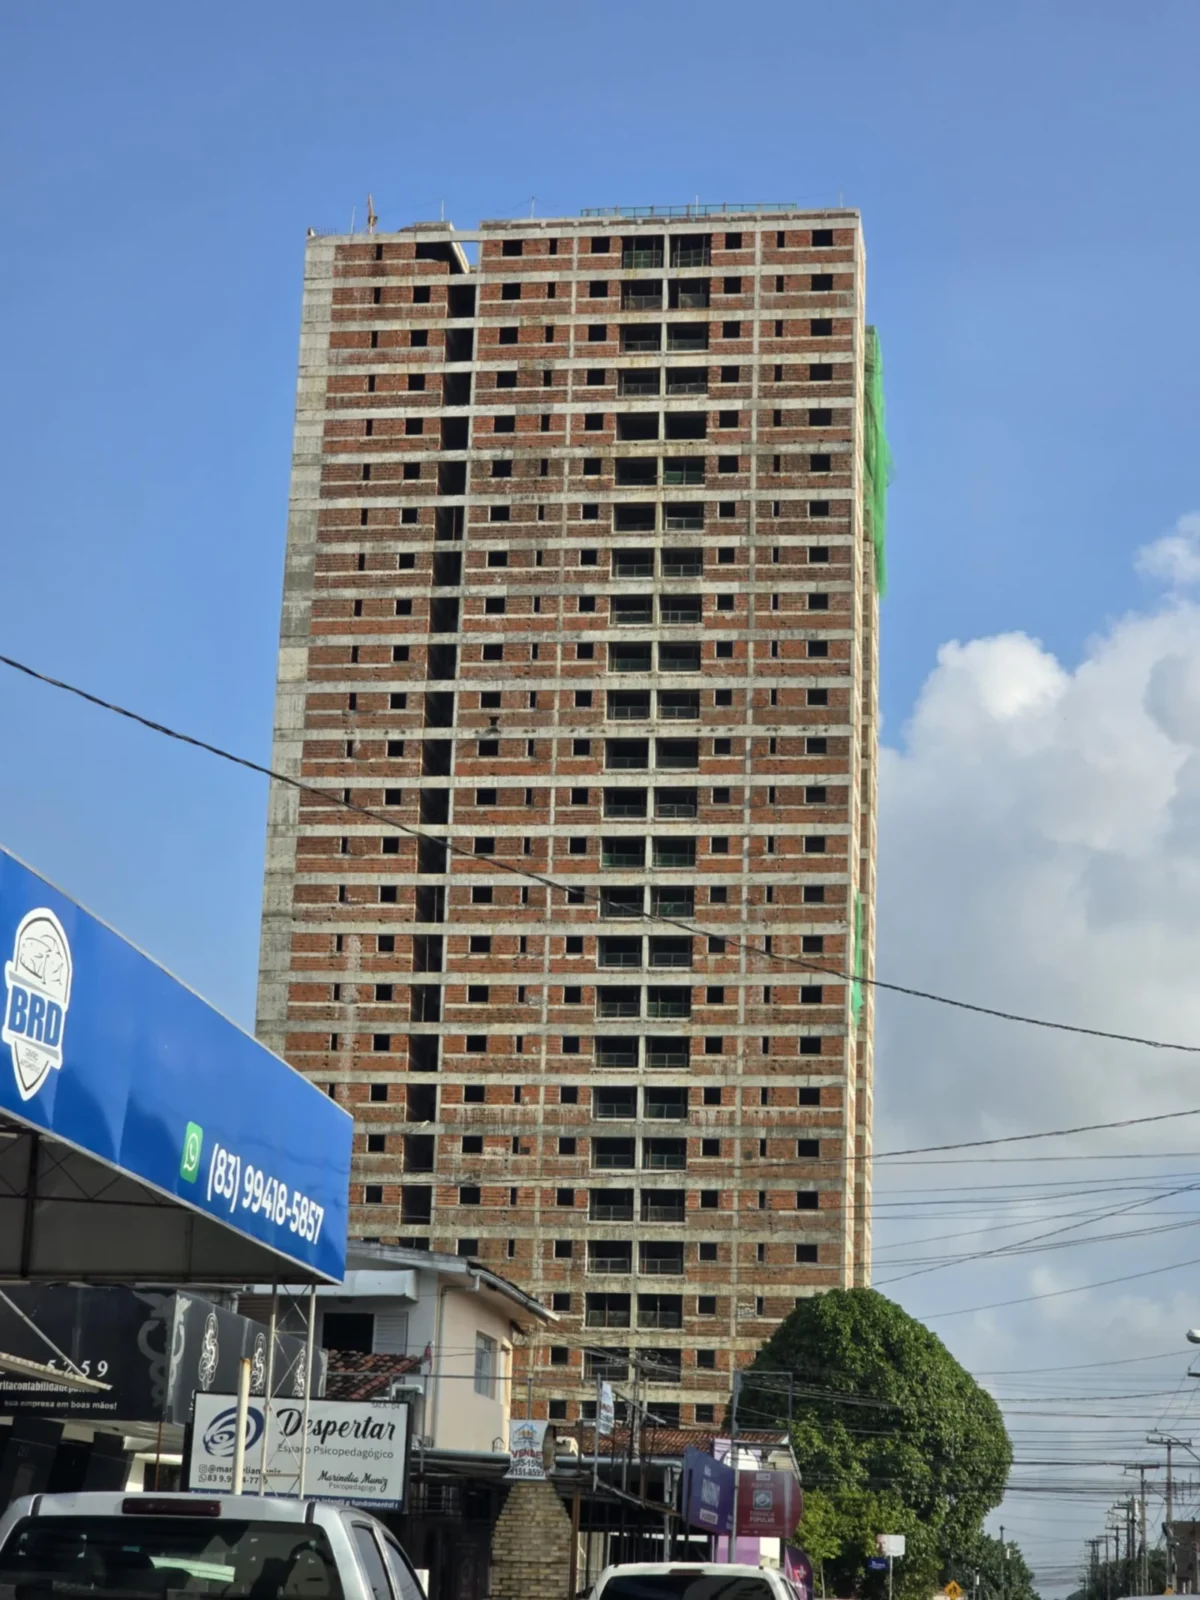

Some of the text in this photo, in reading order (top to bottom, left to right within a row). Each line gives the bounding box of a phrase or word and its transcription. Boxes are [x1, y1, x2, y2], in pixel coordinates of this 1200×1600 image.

[8, 984, 63, 1048] BRD
[207, 1143, 324, 1245] (83) 99418-5857
[20, 1400, 55, 1409] empresa
[70, 1400, 91, 1409] boas
[276, 1407, 396, 1445] Despertar
[313, 1445, 394, 1461] Psicopedagógico
